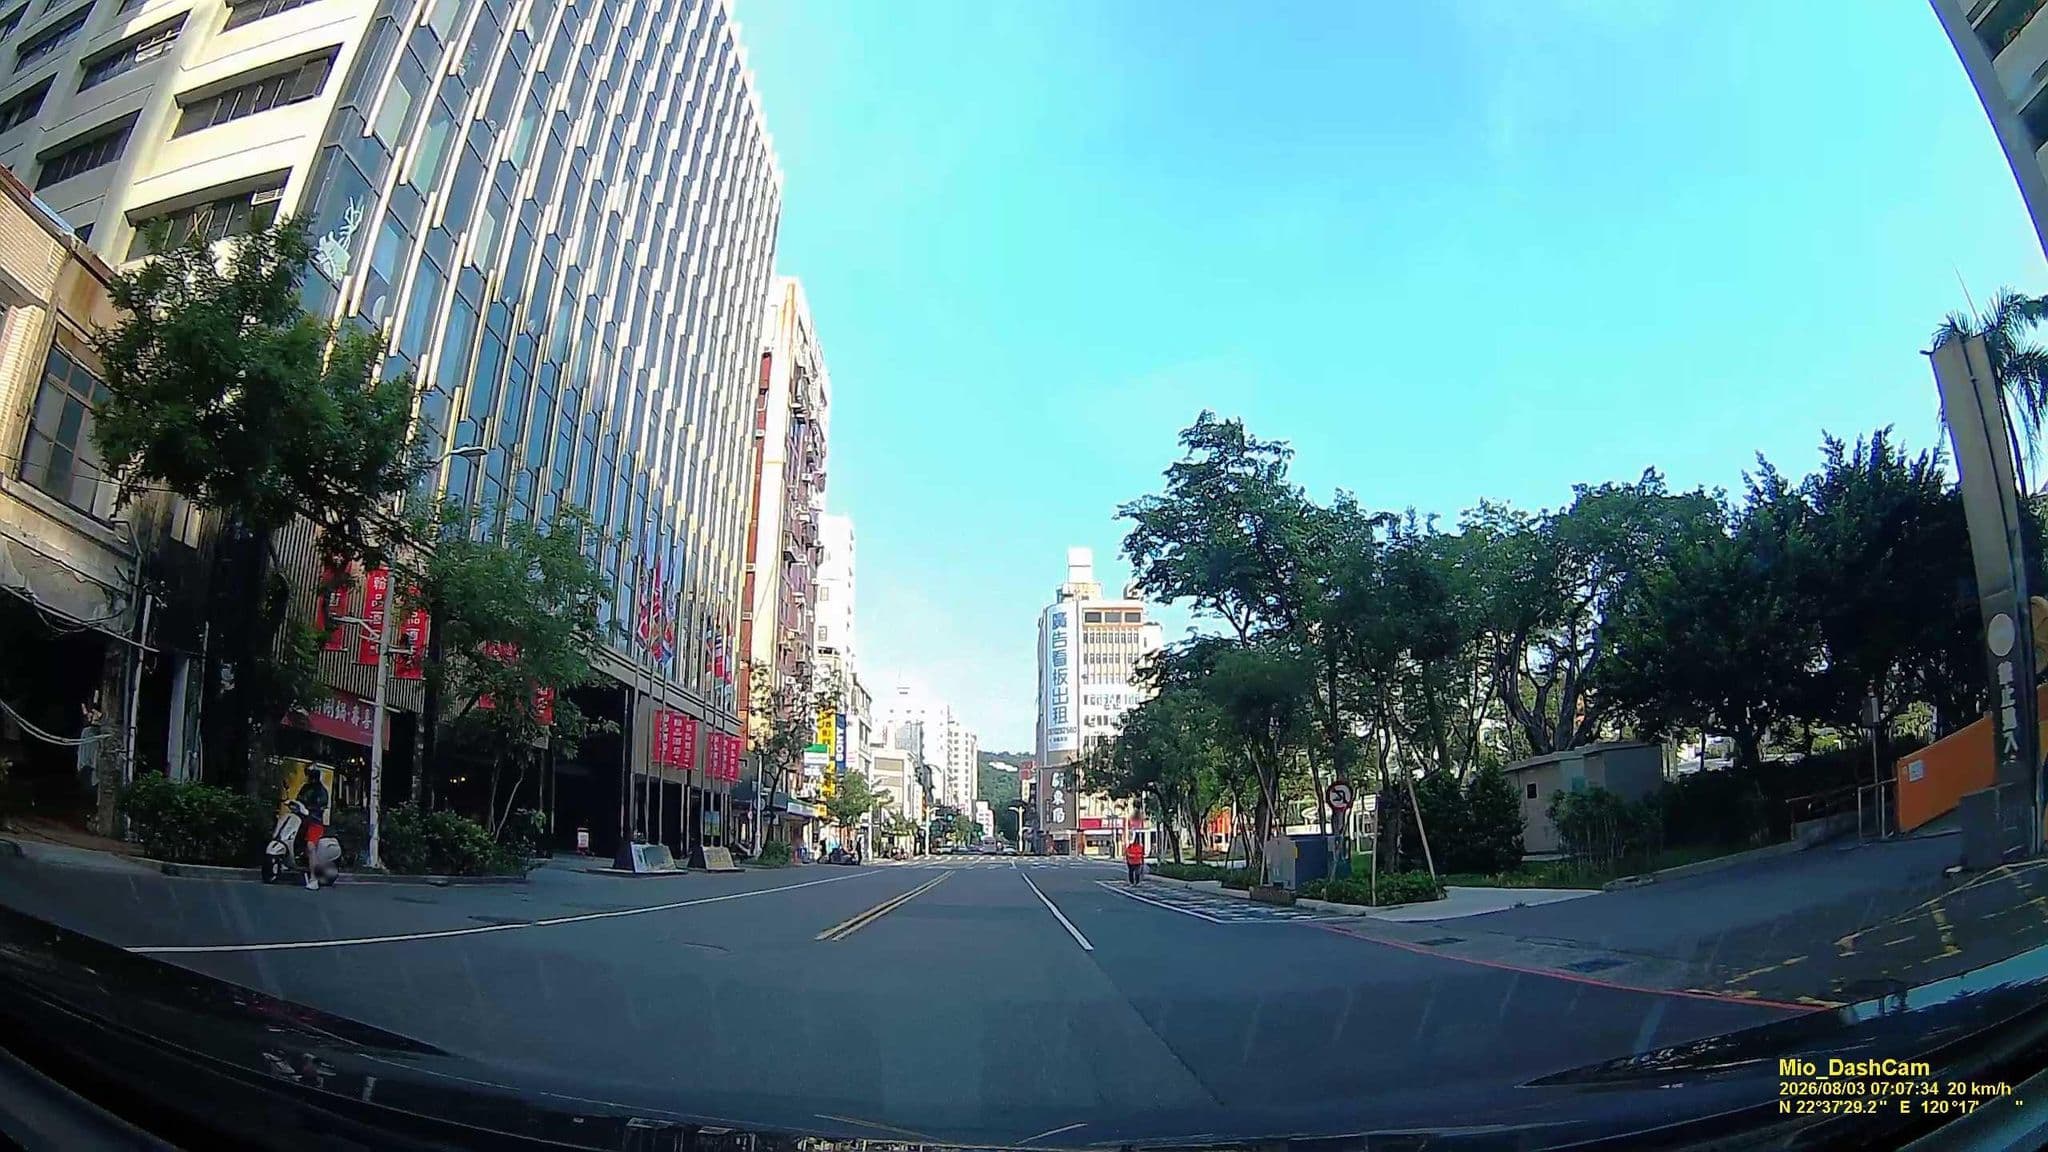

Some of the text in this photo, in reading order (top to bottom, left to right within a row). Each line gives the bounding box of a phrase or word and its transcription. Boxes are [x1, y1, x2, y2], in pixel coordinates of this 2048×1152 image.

[1051, 612, 1069, 725] 廣告看板出租
